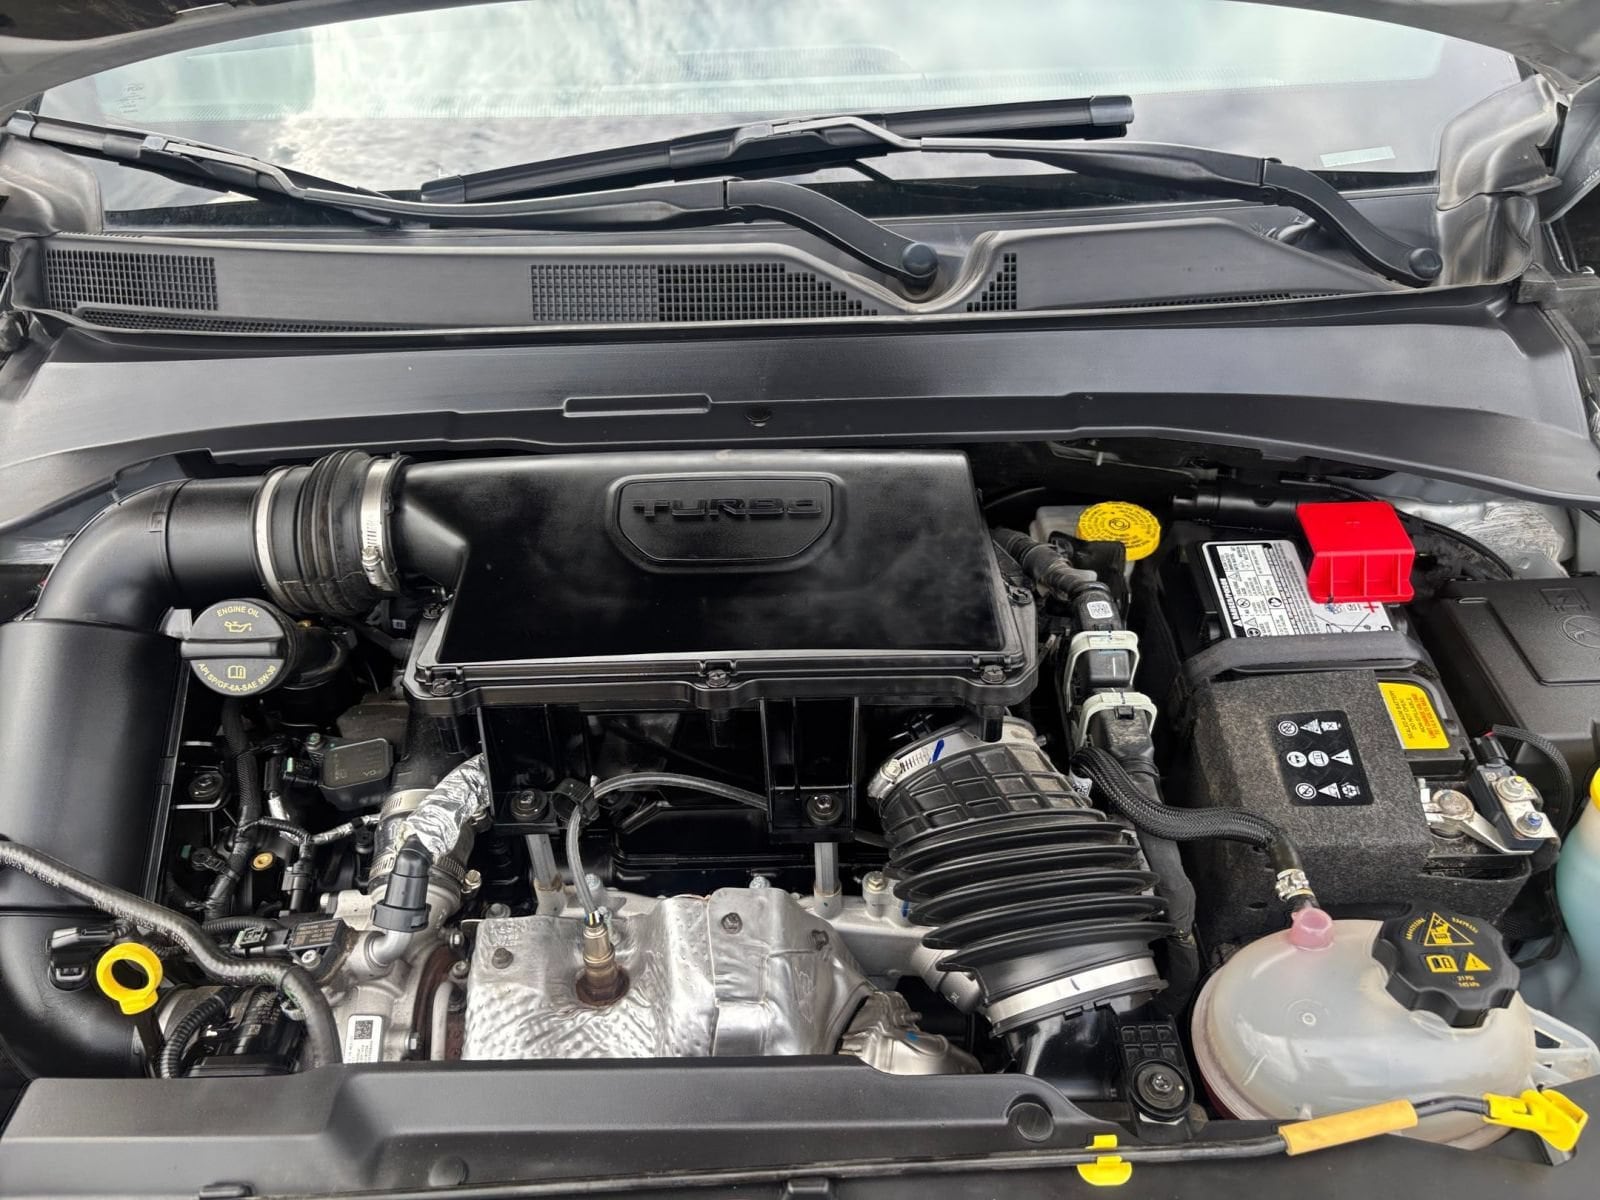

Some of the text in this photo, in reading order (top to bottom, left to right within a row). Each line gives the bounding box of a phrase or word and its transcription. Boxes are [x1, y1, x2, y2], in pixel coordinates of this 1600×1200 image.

[632, 498, 822, 518] TURBO
[216, 606, 260, 618] ENGINE OIL
[198, 663, 209, 676] API
